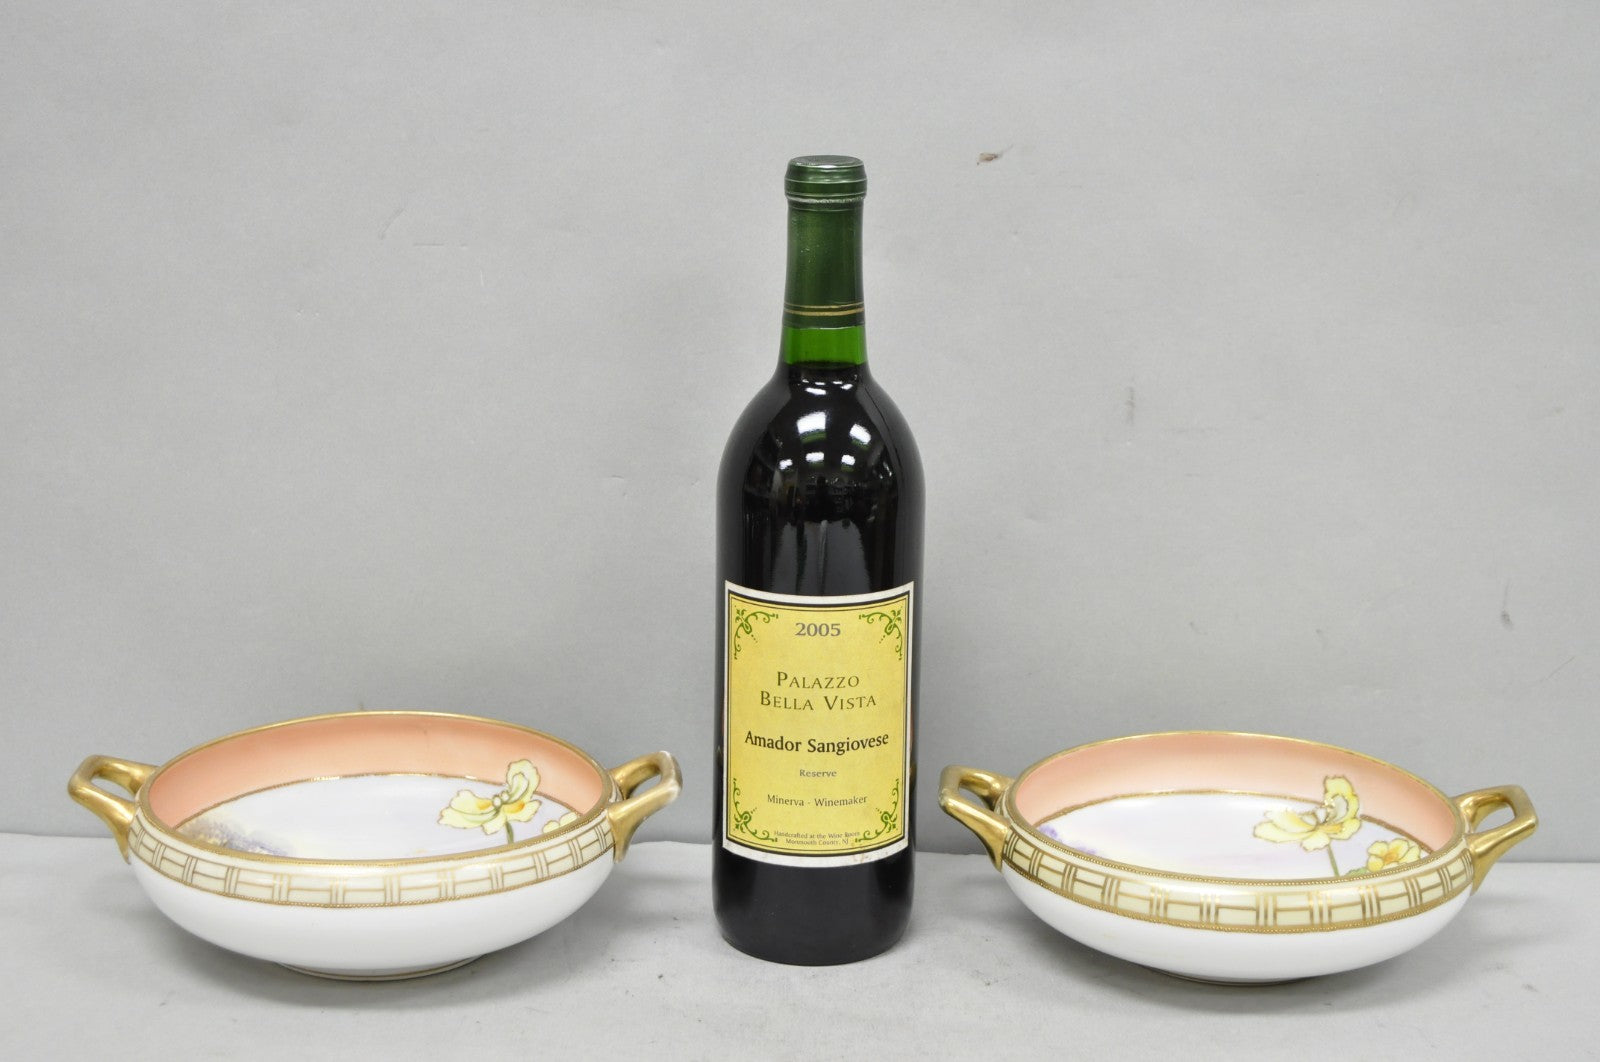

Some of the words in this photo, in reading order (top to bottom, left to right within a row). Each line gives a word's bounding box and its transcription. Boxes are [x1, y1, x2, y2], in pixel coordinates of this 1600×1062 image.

[795, 622, 841, 637] 2005
[776, 671, 860, 689] PALAZZO
[760, 690, 814, 710] BELLA
[824, 695, 877, 710] VISTA
[744, 730, 802, 752] Amador
[807, 733, 889, 755] Sangiovese
[799, 769, 837, 778] Reserve
[767, 794, 804, 807] Minerva
[814, 794, 868, 807] Winemaker
